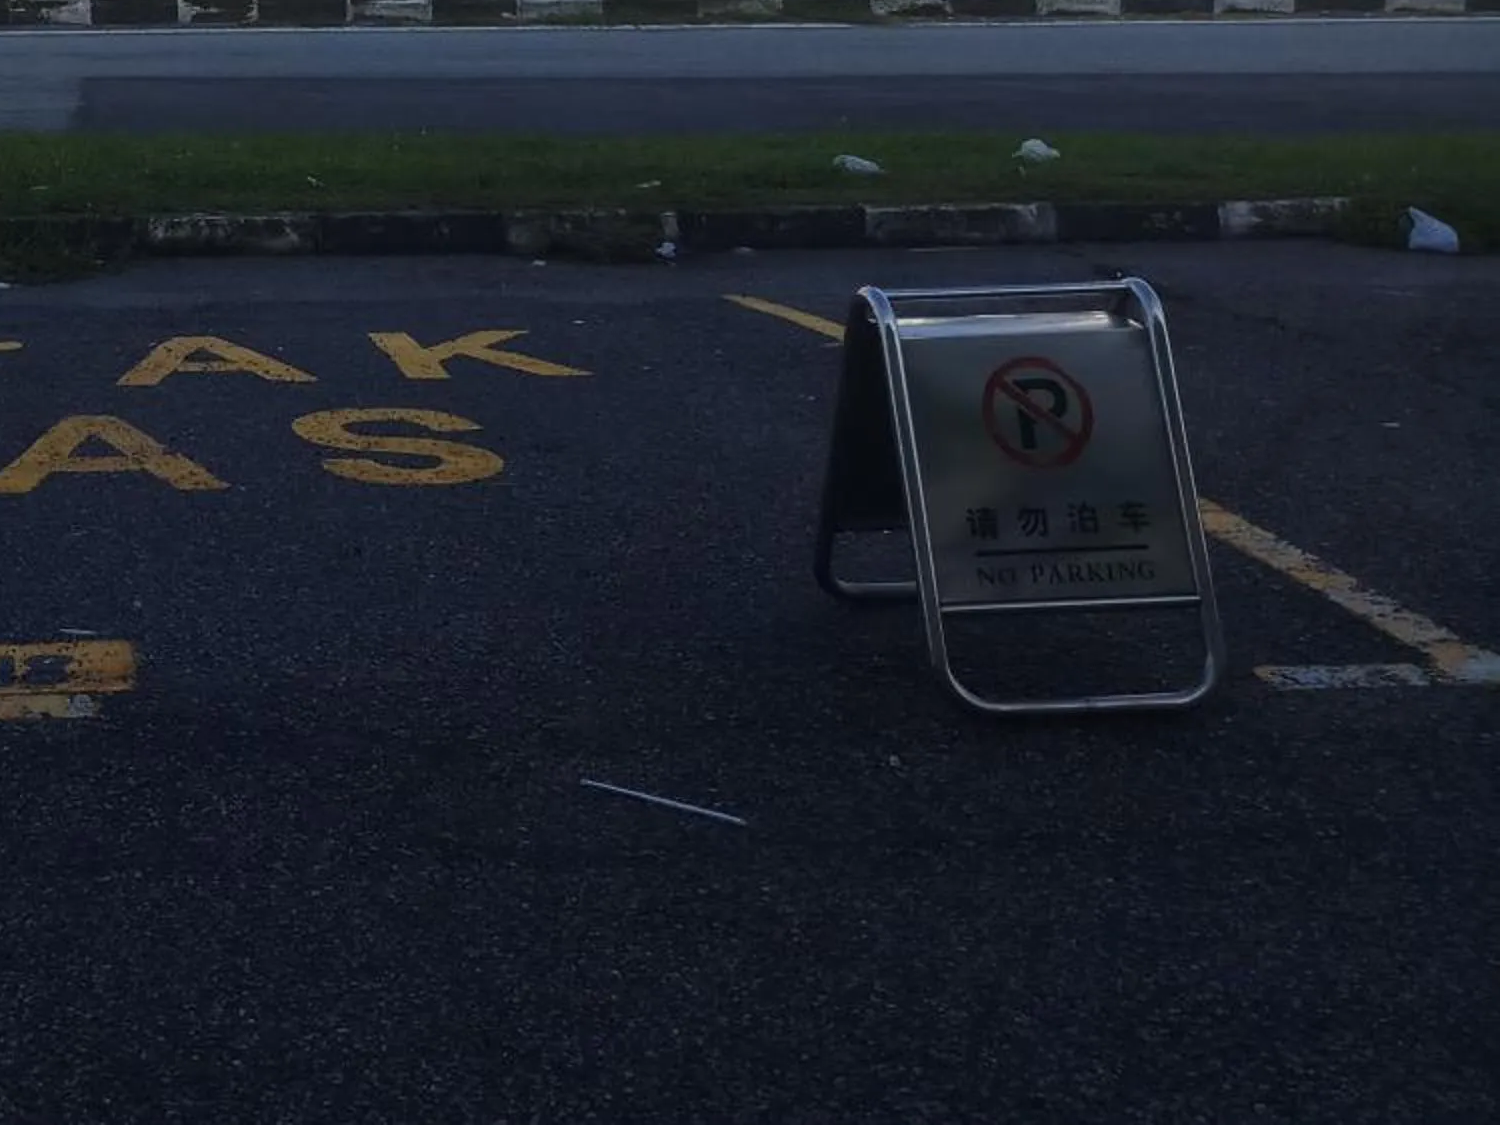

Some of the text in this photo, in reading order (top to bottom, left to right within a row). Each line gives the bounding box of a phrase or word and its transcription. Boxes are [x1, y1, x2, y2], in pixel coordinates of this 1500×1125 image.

[965, 501, 1152, 540] 请勿泊车
[975, 560, 1156, 588] NO PARKING
